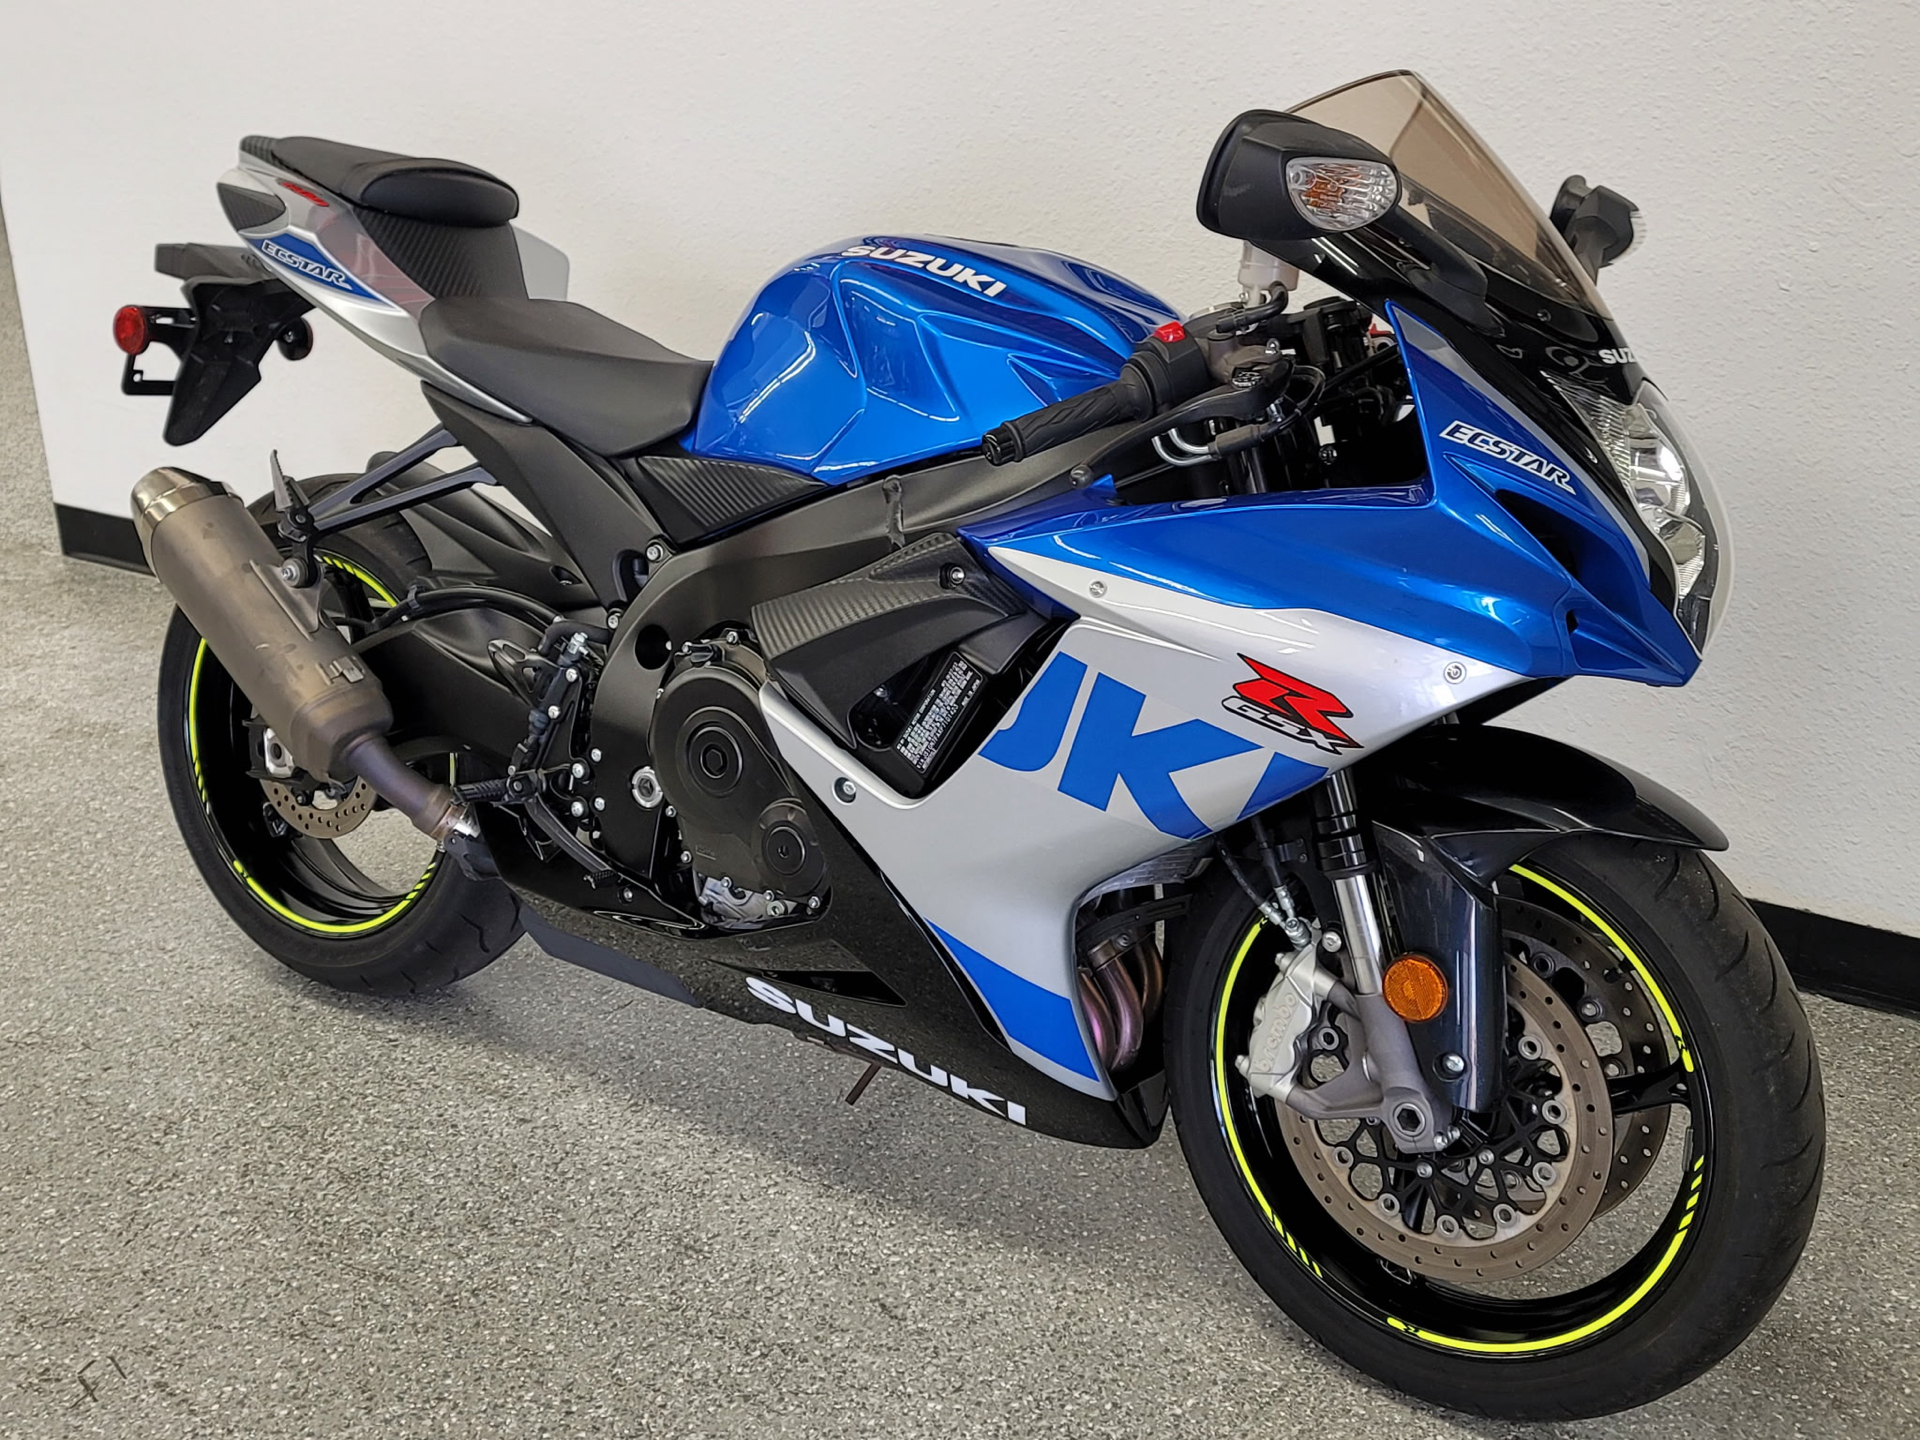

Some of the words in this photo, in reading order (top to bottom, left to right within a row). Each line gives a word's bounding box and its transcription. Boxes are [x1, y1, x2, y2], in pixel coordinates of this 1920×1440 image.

[261, 240, 353, 290] ECSTAR
[841, 245, 1007, 297] SUZUKI
[1439, 420, 1576, 495] ECSTAR
[746, 977, 1026, 1125] SUZUKI
[1253, 992, 1297, 1073] brembo
